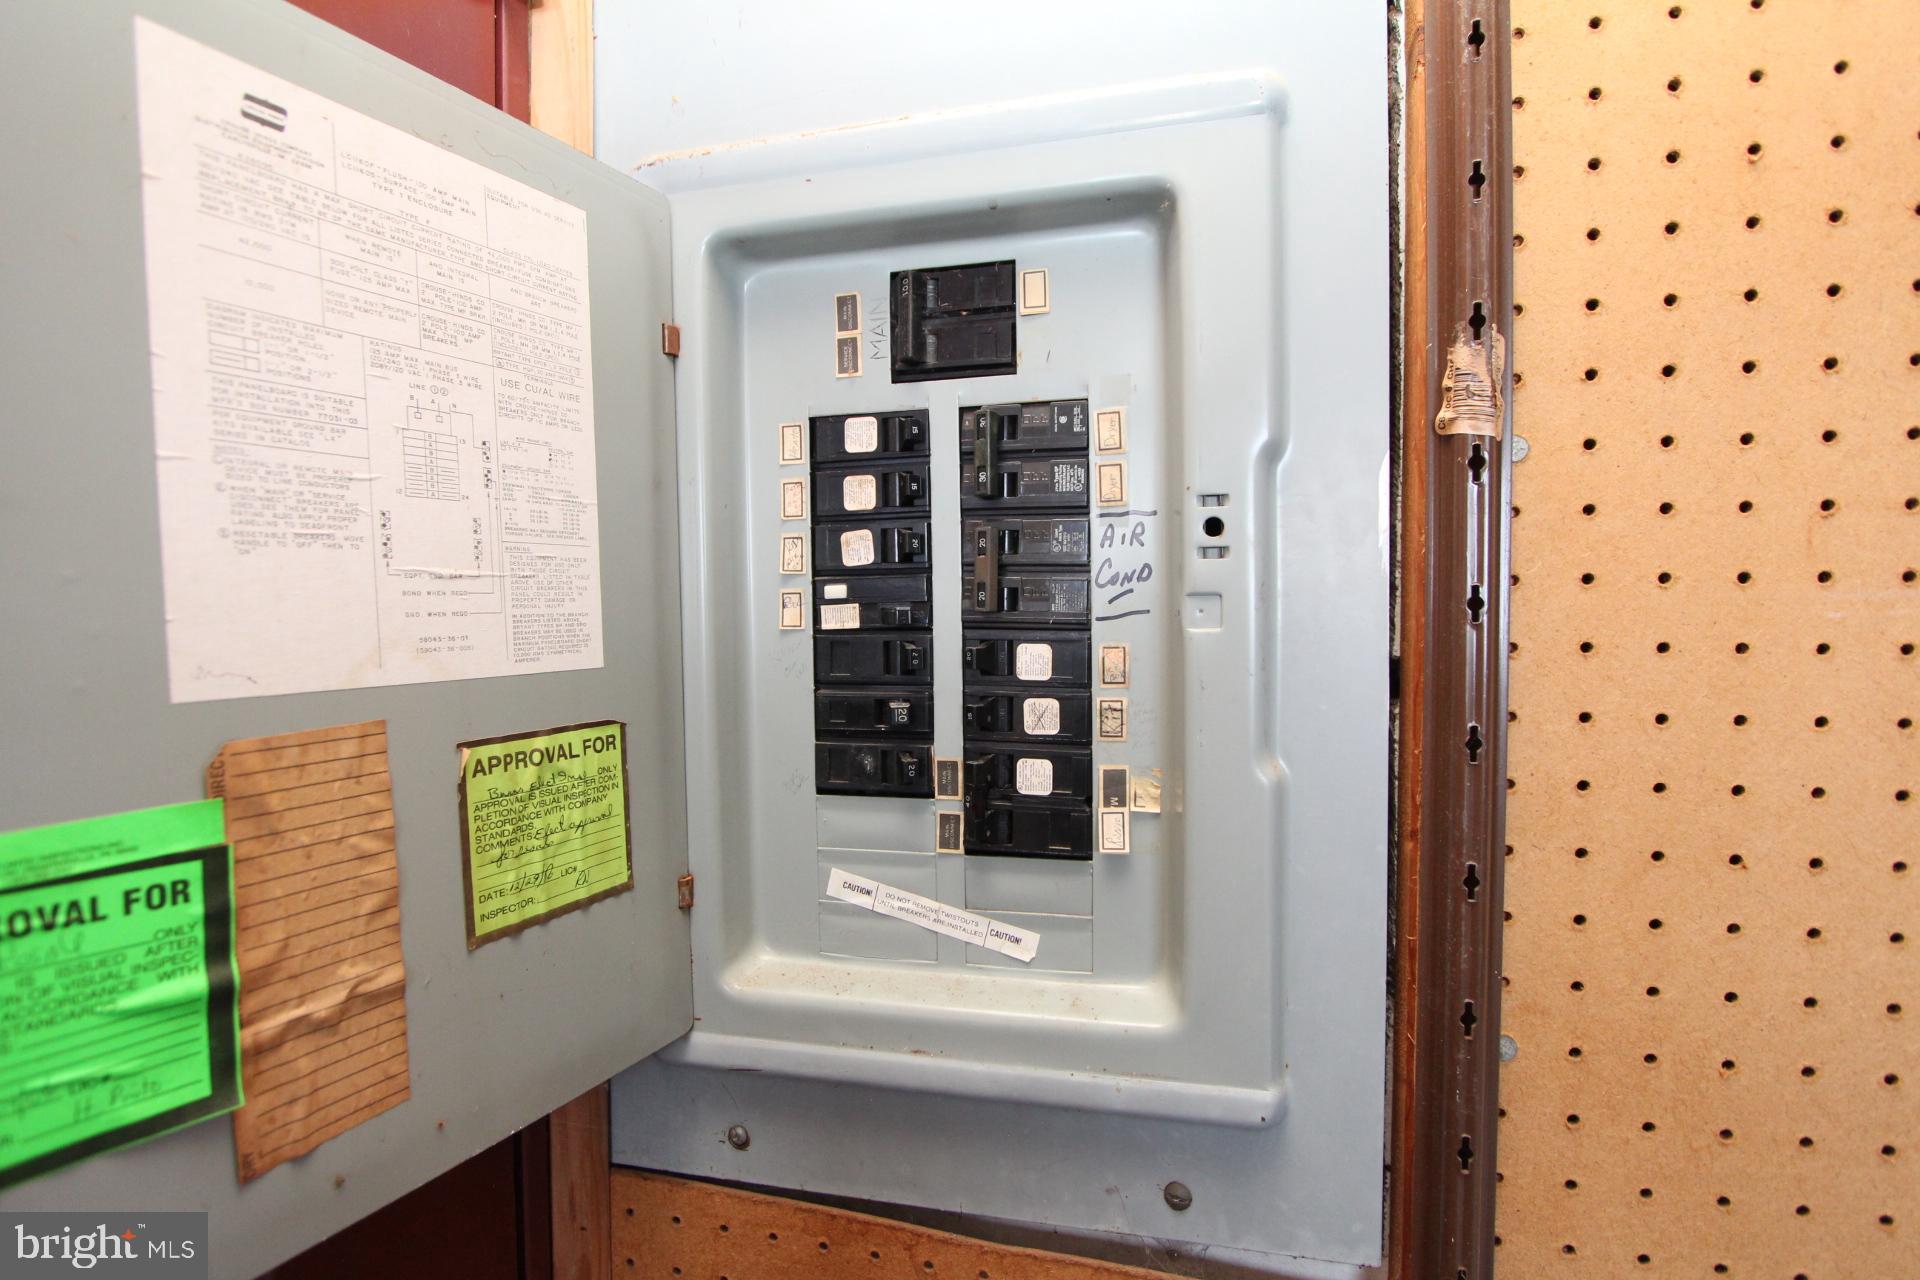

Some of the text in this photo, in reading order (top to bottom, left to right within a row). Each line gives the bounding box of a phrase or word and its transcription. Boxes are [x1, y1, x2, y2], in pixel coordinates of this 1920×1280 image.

[868, 296, 888, 360] MAIN
[424, 359, 442, 370] MAIN
[409, 382, 426, 392] LINE
[500, 378, 580, 403] USE CU/AL WIRE
[912, 426, 919, 434] 15
[912, 482, 918, 490] 15
[979, 472, 987, 483] 30
[912, 538, 919, 548] 20
[979, 537, 986, 548] 20
[979, 591, 986, 602] 20
[912, 652, 918, 664] 20
[898, 708, 908, 722] 20
[1102, 704, 1124, 734] Kit
[472, 743, 580, 778] APPROVAL
[582, 734, 616, 756] FOR
[598, 765, 618, 776] ONLY
[908, 765, 915, 778] 20
[474, 796, 528, 814] APPROVAL
[529, 792, 536, 800] IS
[570, 778, 596, 790] AFTER
[598, 773, 619, 784] COM-
[1110, 796, 1118, 807] M
[474, 781, 619, 824] PLETION OF VISUAL INSPECTION IN
[474, 794, 608, 834] ACCORDANCE WITH COMPANY
[479, 890, 509, 905] DATE:
[842, 881, 874, 898] CAUTION!
[0, 878, 192, 941] OVAL FOR
[480, 897, 536, 922] INSPECTOR:
[877, 898, 984, 938] UNTIL BREAKERS ARE INSTALLED
[886, 892, 979, 928] DO NOT REMOVE TWISTOUTS
[154, 922, 198, 942] ONLY
[990, 928, 1023, 946] CAUTION!
[145, 936, 198, 957] AFTER
